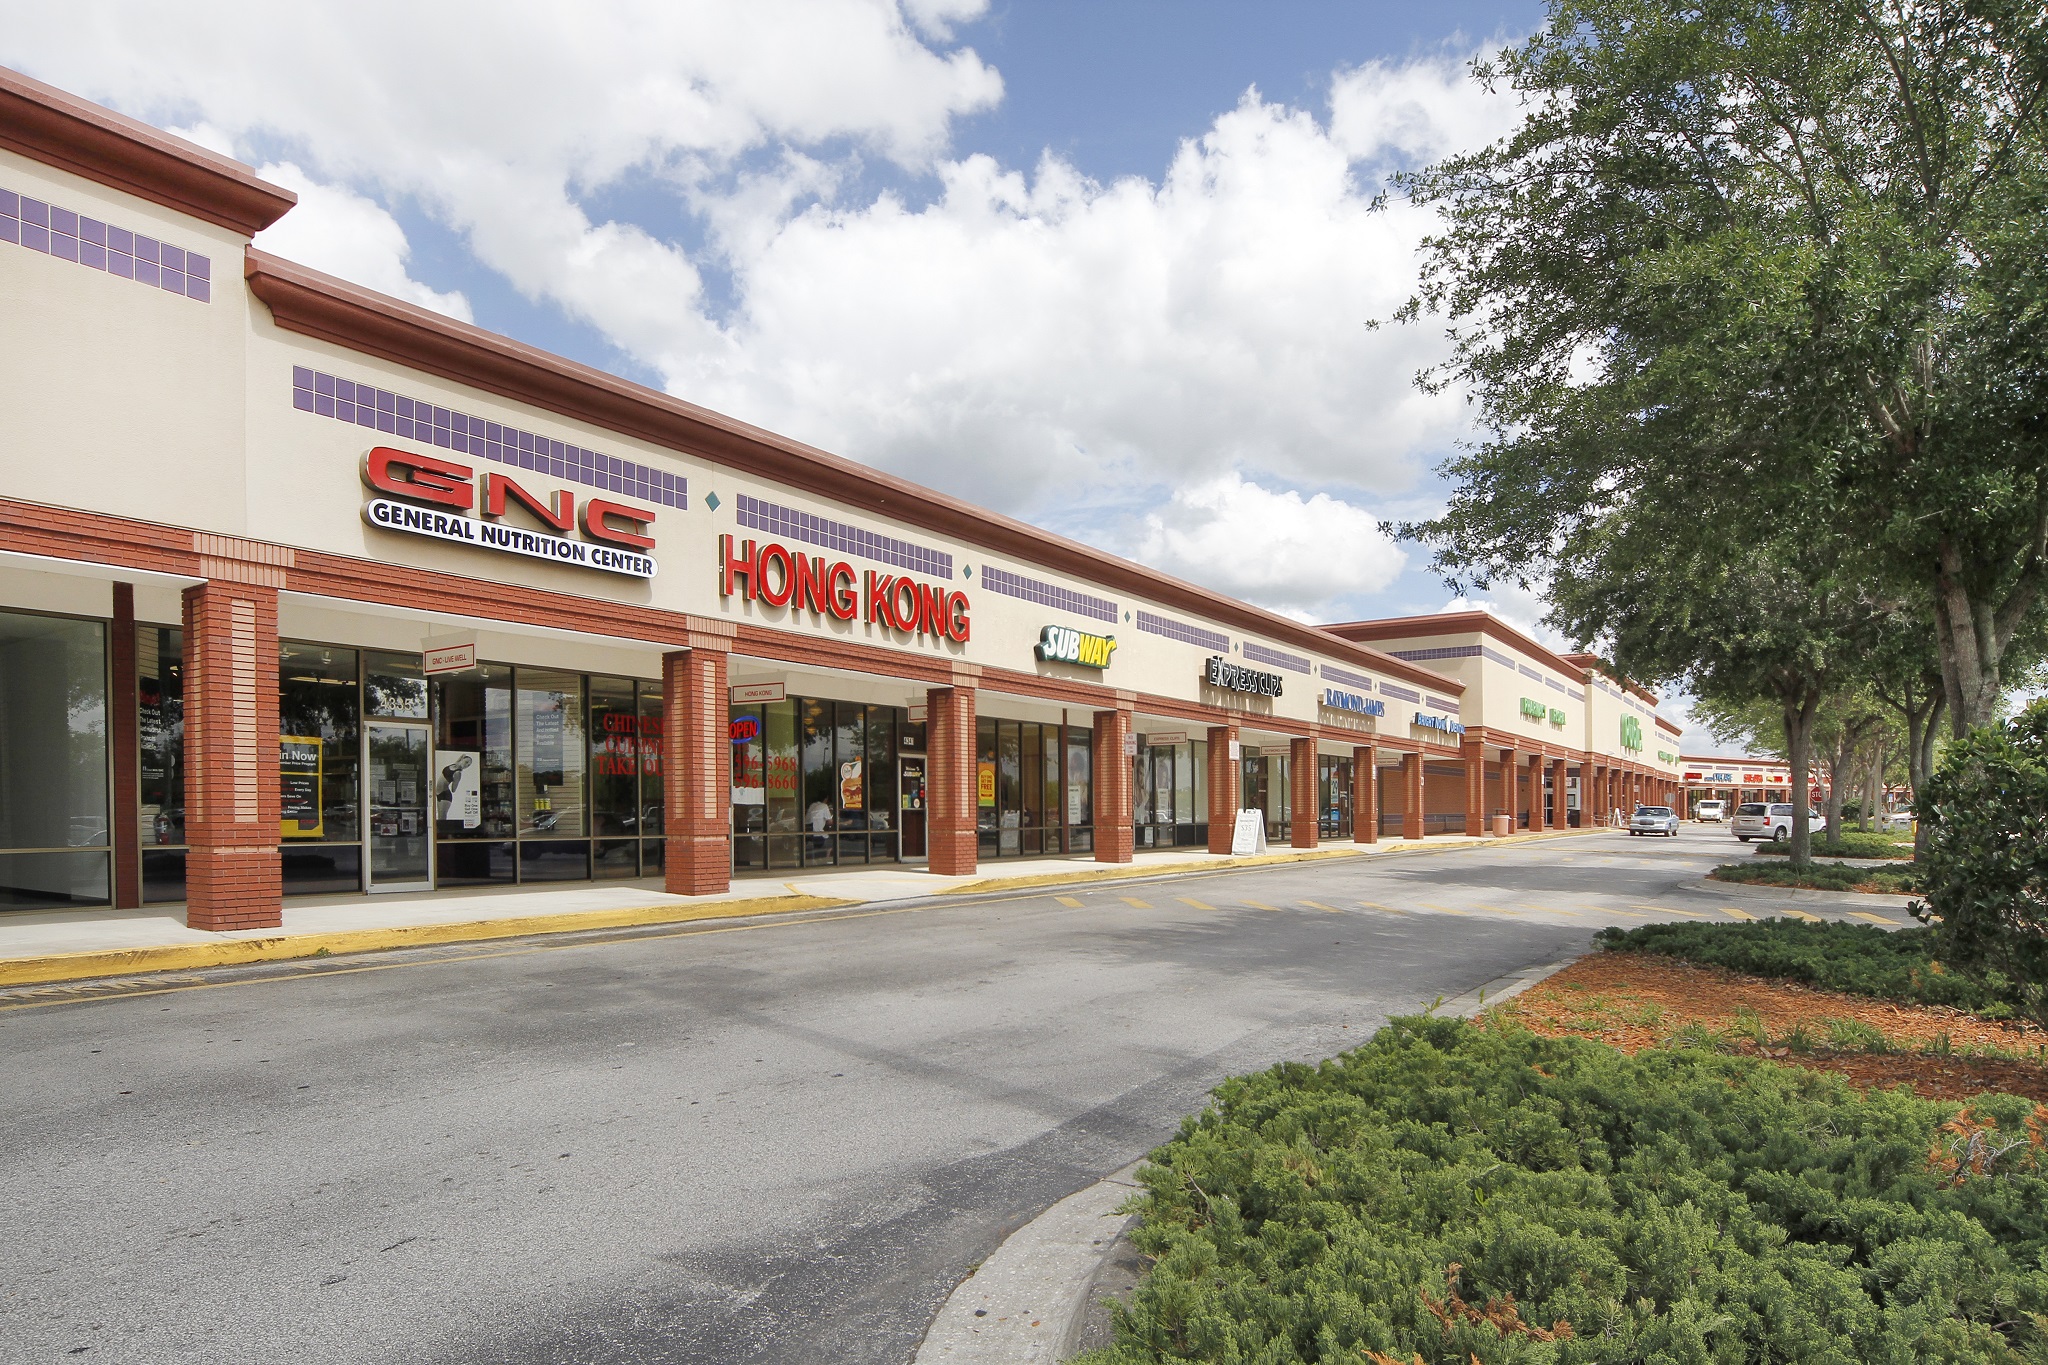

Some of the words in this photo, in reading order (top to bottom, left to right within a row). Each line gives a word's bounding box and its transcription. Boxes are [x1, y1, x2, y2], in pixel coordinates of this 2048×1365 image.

[361, 446, 656, 550] GNC
[373, 502, 475, 540] GENERAL
[481, 525, 586, 562] NUTRITION
[591, 548, 653, 576] CENTER
[719, 533, 858, 620] HONG
[863, 569, 971, 643] KONG
[1041, 626, 1118, 667] SUBWAY
[1206, 656, 1258, 693] EXPRESS
[1257, 671, 1283, 697] CLIPS
[380, 697, 413, 711] 4335
[729, 721, 757, 739] OPEN
[280, 750, 289, 760] in
[292, 750, 317, 761] Now
[596, 755, 637, 775] TAKE
[643, 758, 665, 777] OU
